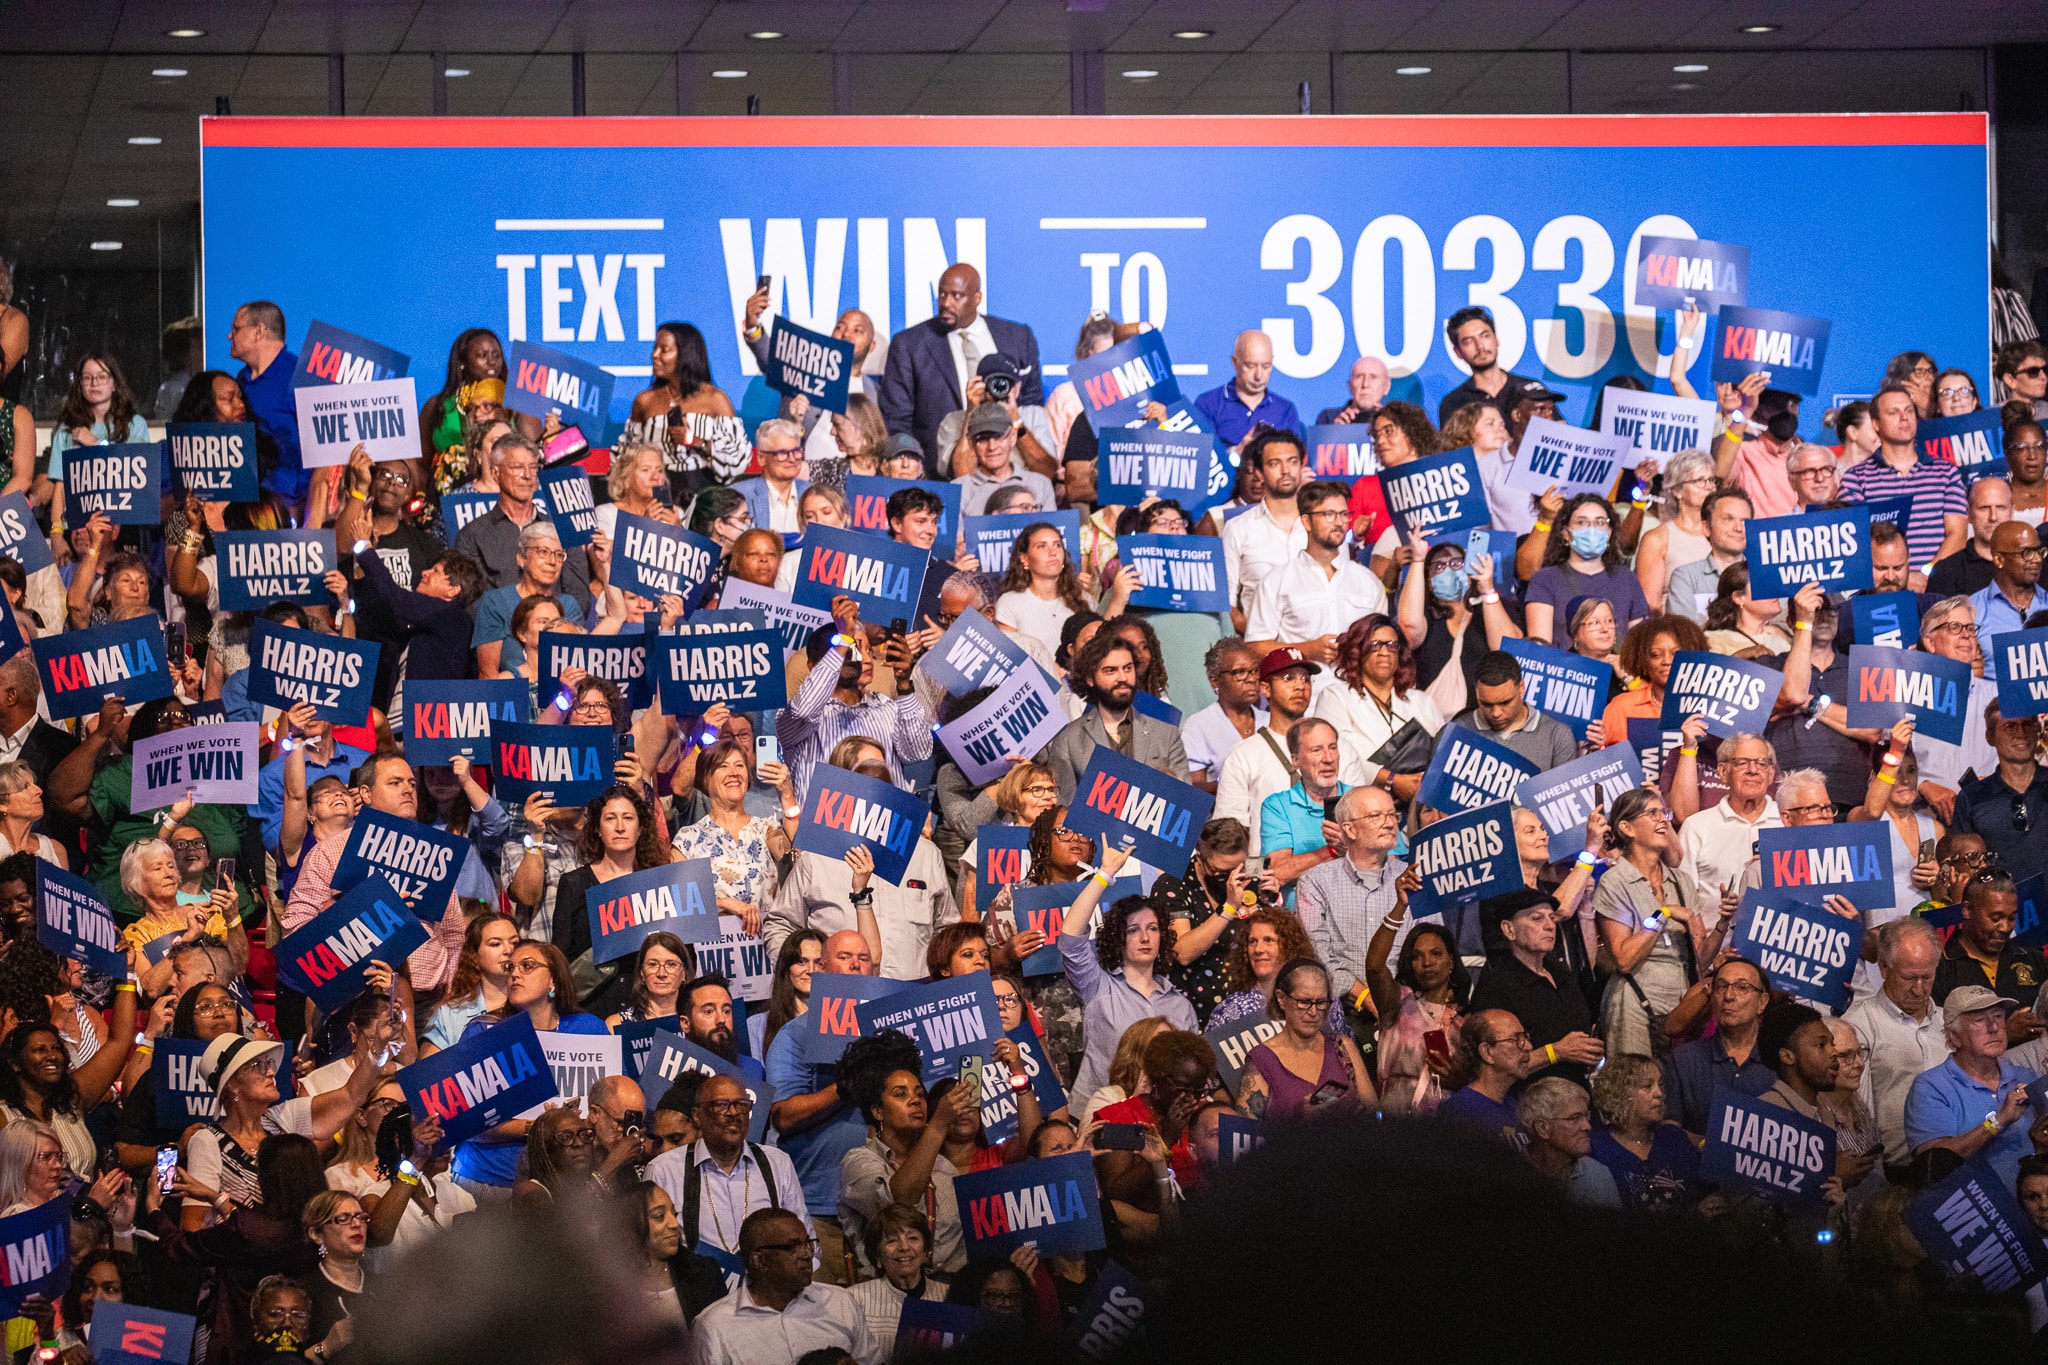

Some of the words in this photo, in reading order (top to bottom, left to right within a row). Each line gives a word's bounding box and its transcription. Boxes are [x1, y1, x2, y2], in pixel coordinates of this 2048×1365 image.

[1646, 253, 1738, 295] KAMALA
[496, 254, 664, 342] TEXT
[720, 218, 986, 376] WIN
[1080, 252, 1168, 335] TO
[775, 329, 842, 381] HARRIS
[1723, 325, 1815, 371] KAMALA
[516, 359, 600, 418] KAMALA
[782, 365, 825, 398] WALZ
[1084, 350, 1172, 411] KAMALA
[313, 399, 348, 412] WHEN
[351, 398, 368, 408] WE
[371, 395, 400, 406] VOTE
[1617, 404, 1647, 417] WHEN
[1651, 410, 1669, 420] WE
[1671, 412, 1700, 424] VOTE
[312, 413, 351, 445] WE
[354, 408, 406, 441] WIN
[1541, 435, 1570, 450] WHEN
[1574, 441, 1590, 453] WE
[1593, 446, 1617, 458] VOTE
[1614, 417, 1645, 448] WE
[1650, 422, 1700, 454] WIN
[171, 435, 244, 469] HARRIS
[1110, 442, 1142, 453] WHEN
[1145, 444, 1163, 454] WE
[1165, 445, 1199, 458] FIGHT
[1529, 445, 1566, 479] WE
[1567, 455, 1614, 485] WIN
[69, 456, 147, 495] HARRIS
[182, 470, 232, 489] WALZ
[1109, 455, 1143, 486] WE
[1148, 455, 1198, 490] WIN
[1387, 462, 1471, 513] HARRIS
[80, 492, 132, 513] WALZ
[1404, 500, 1462, 528] WALZ
[1870, 509, 1900, 524] FIGHT
[624, 525, 711, 585] HARRIS
[978, 529, 1009, 541] WHEN
[1131, 546, 1162, 558] WHEN
[1164, 548, 1181, 559] WE
[1182, 549, 1212, 560] FIGHT
[1759, 521, 1858, 566] HARRIS
[228, 541, 324, 578] HARRIS
[808, 546, 911, 603] KAMALA
[1133, 557, 1169, 589] WE
[1170, 560, 1216, 592] WIN
[1778, 559, 1845, 585] WALZ
[246, 578, 311, 597] WALZ
[636, 565, 696, 601] WALZ
[739, 595, 773, 613] WHEN
[775, 604, 793, 617] WE
[796, 610, 825, 626] VOTE
[48, 638, 158, 694] KAMALA
[262, 635, 363, 688] HARRIS
[551, 645, 646, 679] HARRIS
[669, 642, 772, 681] HARRIS
[944, 636, 990, 681] WE
[965, 626, 991, 653] WHEN
[993, 651, 1013, 669] WE
[275, 677, 341, 708] WALZ
[689, 680, 757, 703] WALZ
[1546, 664, 1566, 678] WE
[1566, 669, 1598, 686] FIGHT
[1672, 661, 1766, 711] HARRIS
[1860, 666, 1957, 717] KAMALA
[959, 720, 990, 743] WHEN
[989, 703, 1007, 721] WE
[1007, 681, 1033, 707] VOTE
[1544, 678, 1596, 721] WIN
[1679, 695, 1739, 726] WALZ
[414, 701, 517, 739] KAMALA
[963, 727, 1011, 767] WE
[1000, 690, 1051, 745] WIN
[149, 744, 184, 760] WHEN
[186, 740, 206, 752] WE
[208, 738, 241, 748] VOTE
[501, 742, 601, 782] KAMALA
[146, 755, 182, 790] WE
[189, 750, 243, 781] WIN
[1534, 784, 1568, 804] WHEN
[1568, 775, 1589, 791] WE
[1591, 760, 1624, 782] FIGHT
[813, 787, 912, 857] KAMALA
[1086, 771, 1192, 848] KAMALA
[1538, 794, 1588, 835] WE
[357, 823, 453, 882] HARRIS
[1415, 819, 1504, 877] HARRIS
[1773, 844, 1883, 888] KAMALA
[44, 877, 70, 897] WHEN
[72, 889, 87, 904] WE
[88, 896, 112, 918] FIGHT
[1432, 861, 1495, 897] WALZ
[44, 891, 73, 935] WE
[75, 907, 117, 953] WIN
[599, 881, 707, 937] KAMALA
[296, 900, 406, 988] KAMALA
[1748, 905, 1851, 966] HARRIS
[1760, 949, 1829, 987] WALZ
[872, 1009, 914, 1030] WHEN
[914, 1002, 937, 1018] WE
[938, 991, 977, 1011] FIGHT
[922, 1005, 988, 1053] WIN
[569, 1052, 603, 1062] VOTE
[419, 1042, 538, 1121] KAMALA
[549, 1065, 606, 1099] WIN
[1721, 1105, 1825, 1173] HARRIS
[1735, 1152, 1805, 1193] WALZ
[969, 1180, 1088, 1240] KAMALA
[1932, 1188, 1989, 1249] WE
[1966, 1179, 2000, 1220] WHEN
[1995, 1219, 2016, 1242] WE
[2008, 1240, 2036, 1276] FIGHT
